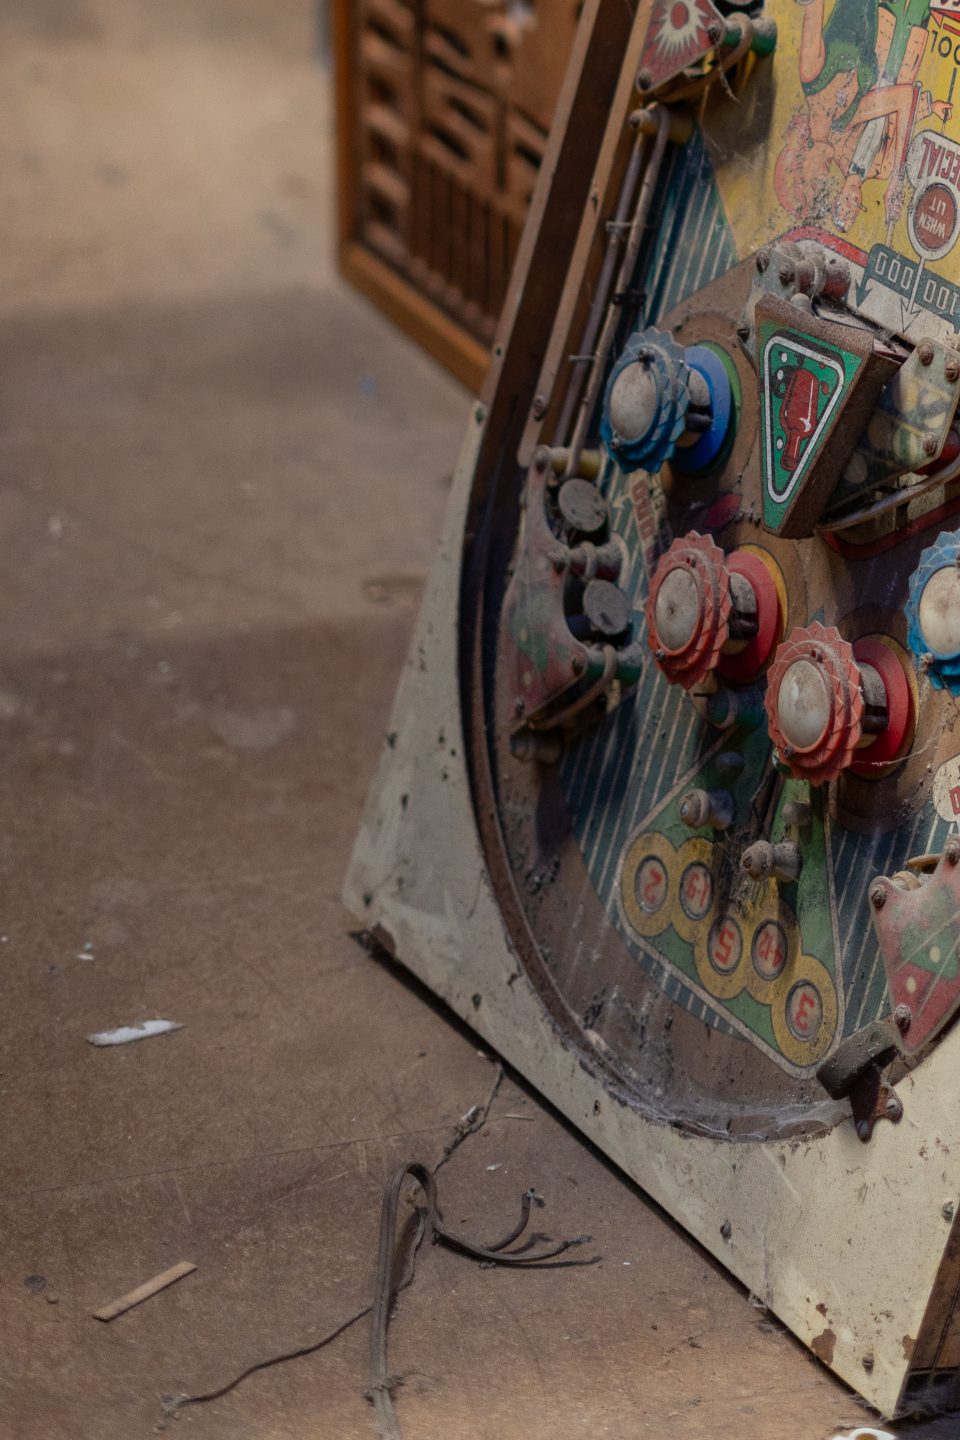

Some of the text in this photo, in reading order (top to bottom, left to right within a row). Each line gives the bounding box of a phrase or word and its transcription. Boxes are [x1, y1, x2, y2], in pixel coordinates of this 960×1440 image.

[929, 196, 947, 217] LIT
[919, 212, 947, 239] WHEN
[642, 868, 662, 904] 2
[714, 926, 735, 966] 5
[794, 992, 815, 1030] 3
